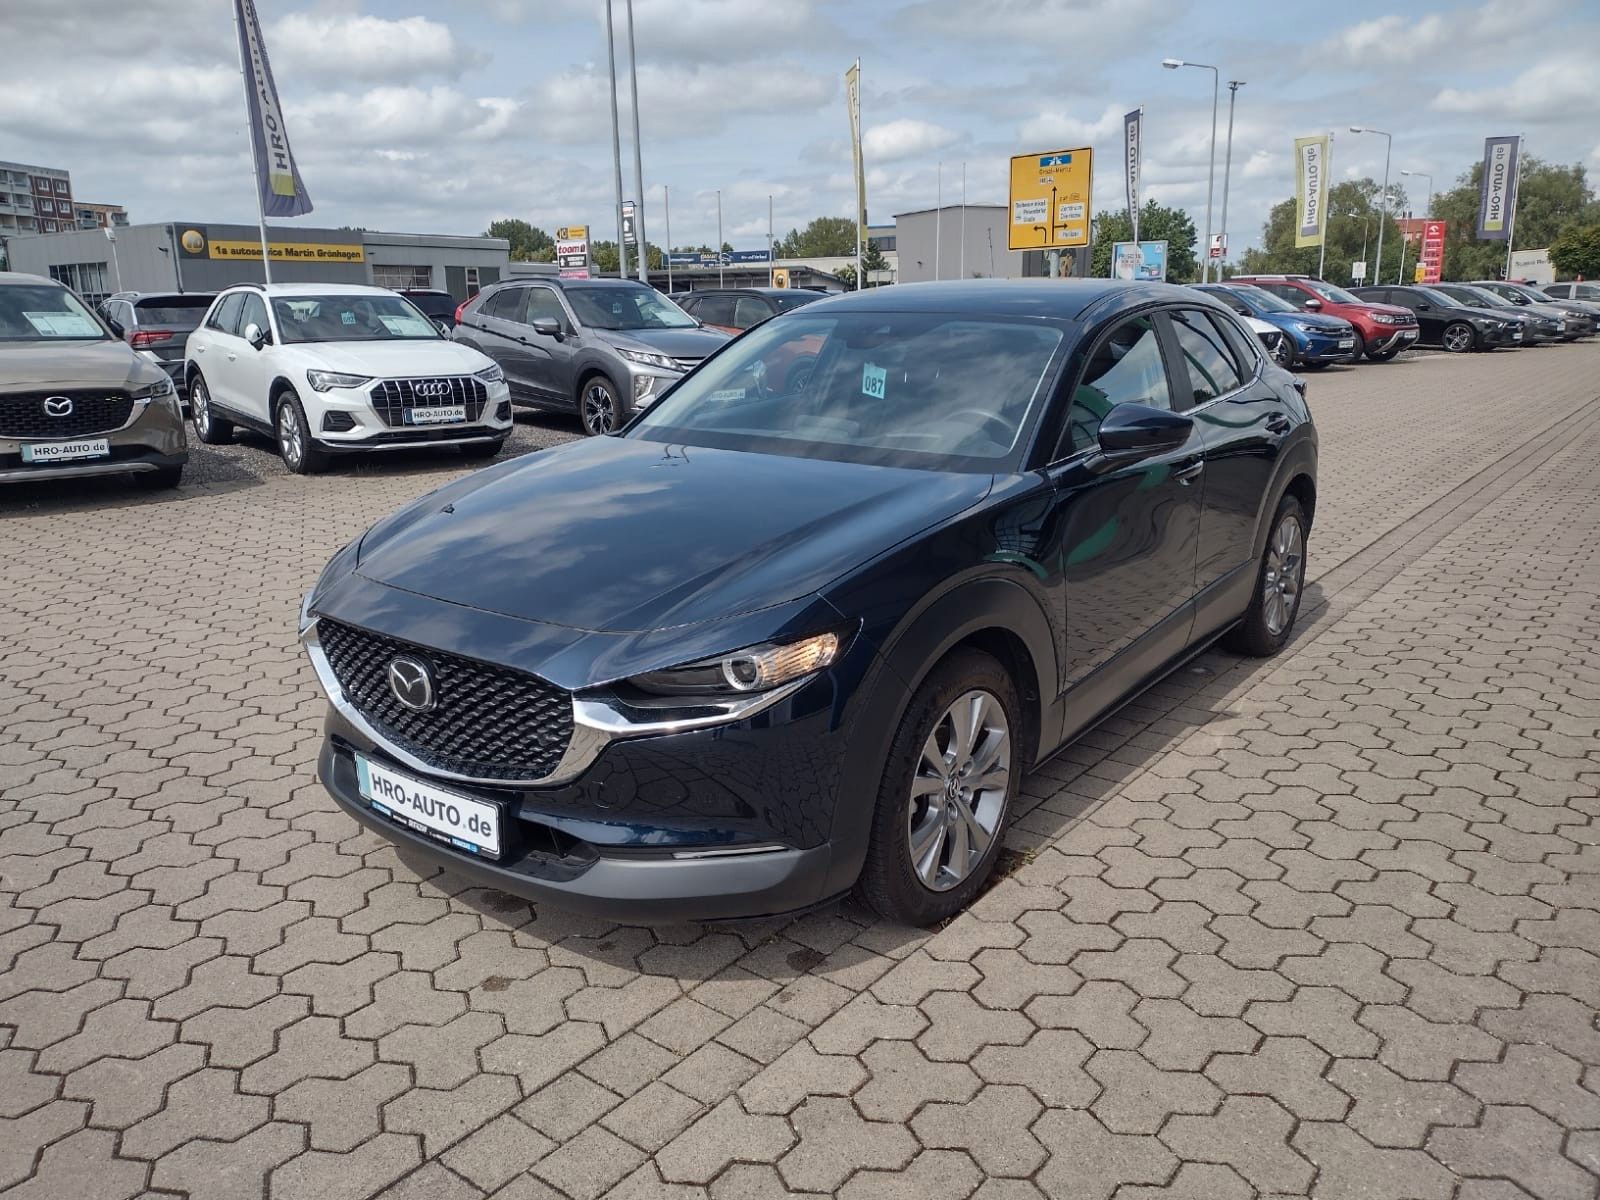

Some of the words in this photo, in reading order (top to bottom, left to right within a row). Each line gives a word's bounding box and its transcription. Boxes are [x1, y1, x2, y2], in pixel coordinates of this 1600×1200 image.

[215, 246, 228, 255] 1a
[285, 248, 315, 257] Martin
[317, 248, 361, 260] Grönhagen
[865, 375, 884, 394] 087
